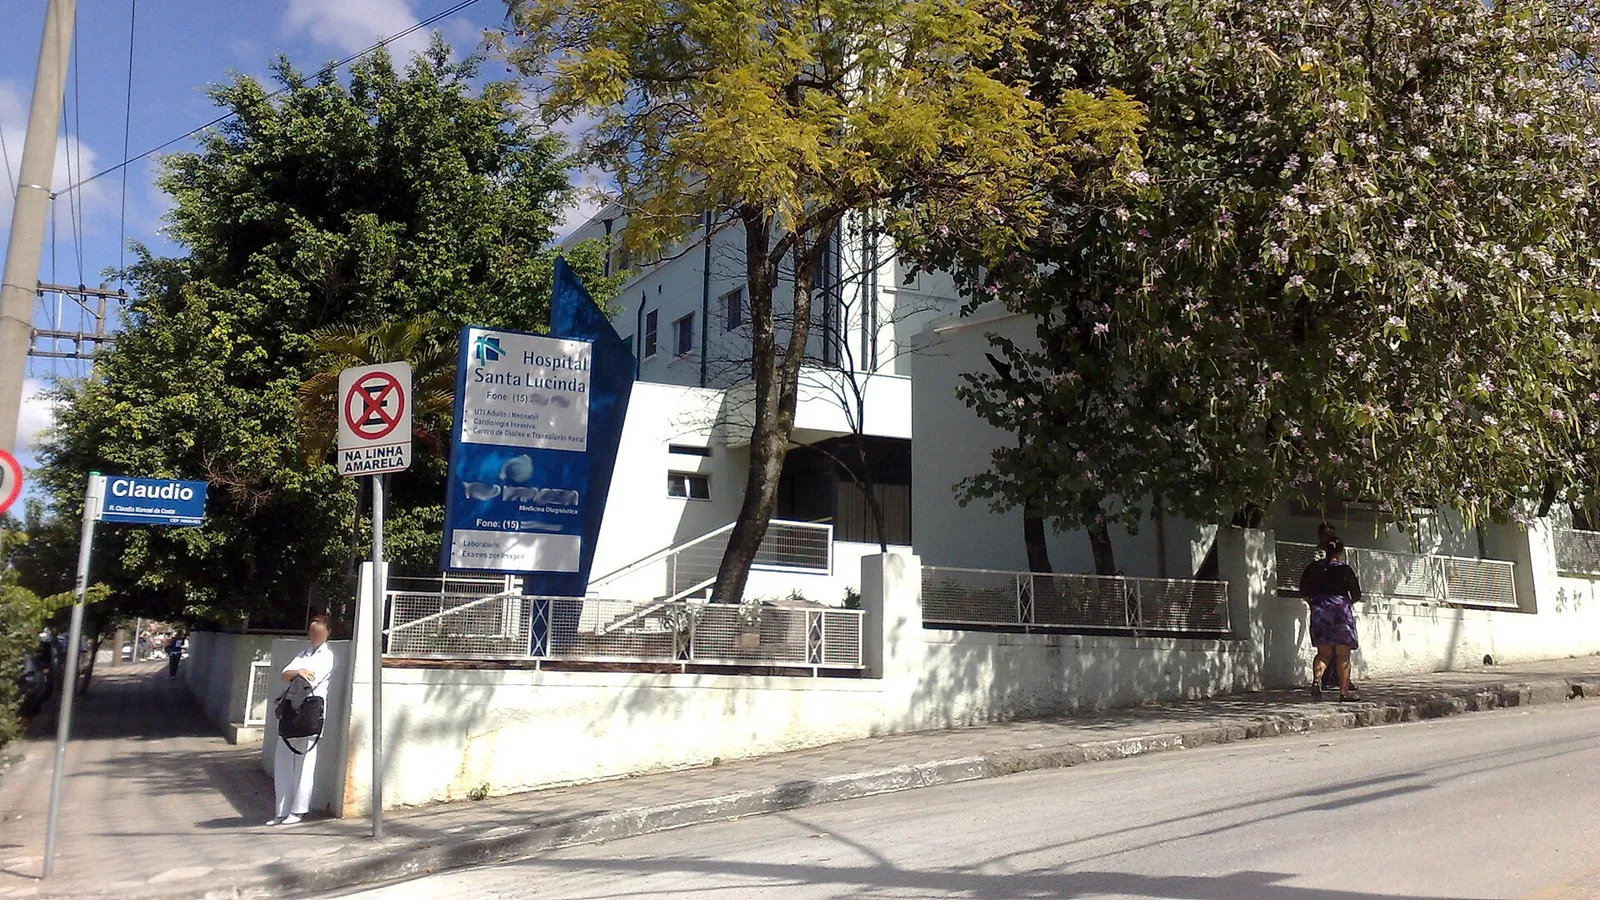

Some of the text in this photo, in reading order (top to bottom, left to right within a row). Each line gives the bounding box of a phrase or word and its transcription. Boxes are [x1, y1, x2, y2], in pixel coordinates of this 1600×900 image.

[523, 350, 587, 371] Hospital
[474, 368, 586, 393] Santa Lucinda
[486, 410, 507, 418] Adulto
[511, 412, 539, 420] Neonatal
[473, 418, 509, 427] Cardiologia
[473, 427, 494, 435] Centro
[344, 445, 403, 462] NA LINHA
[344, 457, 404, 472] AMARELA
[112, 480, 193, 500] Claudio
[476, 519, 501, 528] Fone:
[503, 520, 519, 530] (15)
[462, 550, 488, 558] Exames
[488, 552, 500, 560] por
